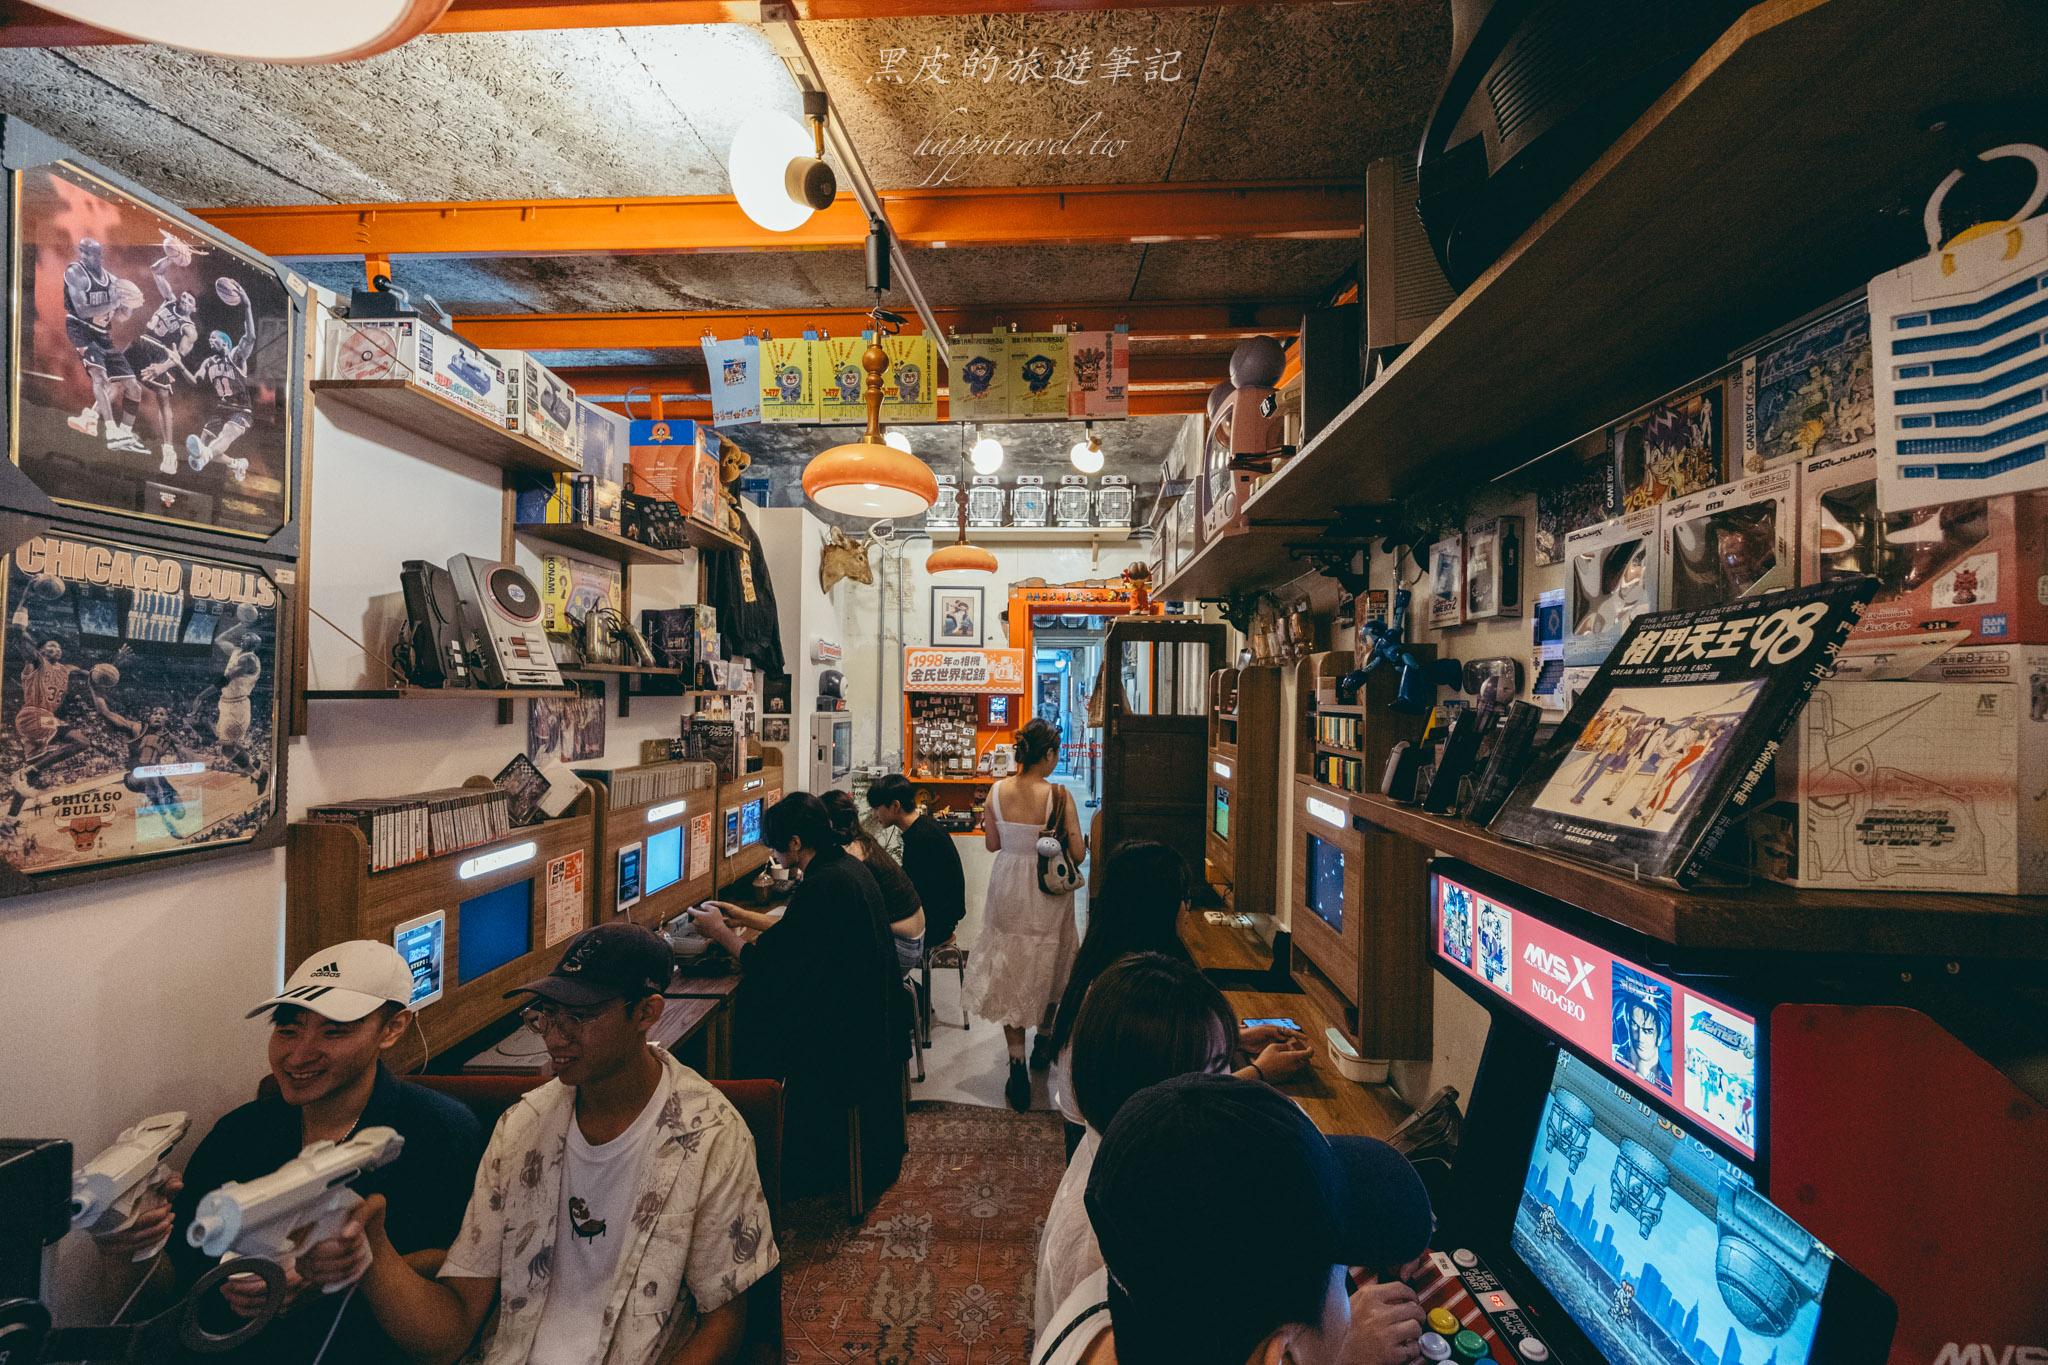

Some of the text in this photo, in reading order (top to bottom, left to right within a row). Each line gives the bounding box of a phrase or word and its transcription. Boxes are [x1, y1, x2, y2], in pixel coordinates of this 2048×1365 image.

[1746, 421, 1755, 451] GAME
[1606, 482, 1614, 509] GAME
[16, 536, 278, 610] CHICAGO BULLS
[547, 556, 556, 594] KONAMI
[1685, 611, 1697, 619] OF
[1701, 604, 1743, 617] FIGHTERS
[1640, 620, 1689, 631] CHARACTER
[1983, 617, 2006, 626] BAN
[1983, 626, 2003, 635] DAI
[911, 667, 986, 682] 金氏世界紀錄
[1636, 667, 1660, 675] MATCH
[1663, 665, 1687, 673] NEVER
[1690, 663, 1713, 671] ENDS
[51, 791, 122, 806] CHICAGO
[62, 803, 111, 817] BULLS
[310, 970, 341, 978] adidas
[1613, 1086, 1651, 1118] 108 10
[1726, 1162, 1742, 1180] 10
[1462, 1271, 1484, 1291] START
[1469, 1268, 1492, 1291] PLAYER
[1481, 1270, 1498, 1286] LEFT
[1500, 1316, 1520, 1336] BACK
